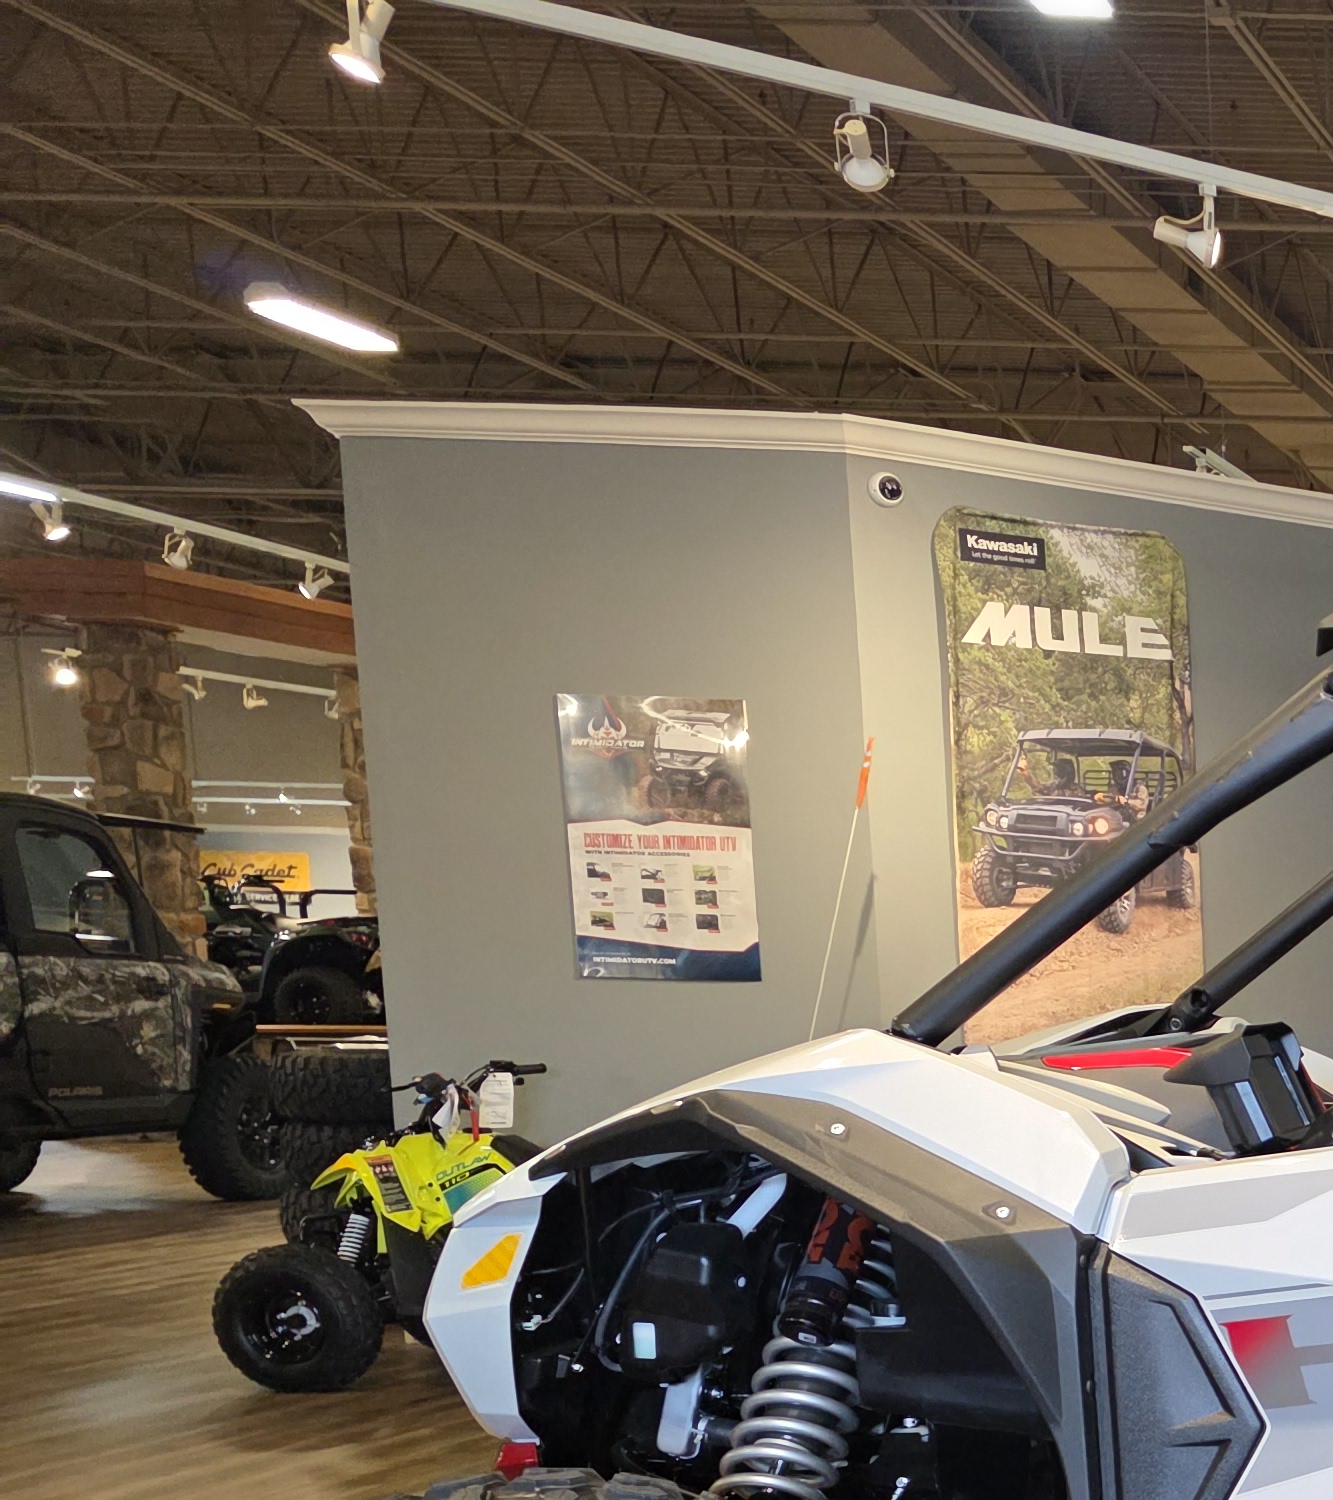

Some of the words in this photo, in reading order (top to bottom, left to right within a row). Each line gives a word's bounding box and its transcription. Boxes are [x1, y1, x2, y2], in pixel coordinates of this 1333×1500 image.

[966, 534, 1038, 556] Kawasaki
[961, 601, 1174, 661] MULE
[571, 738, 645, 748] INTIMIDATOR
[583, 832, 633, 849] CUSTOMIZE
[636, 834, 660, 850] YOUR
[663, 834, 716, 851] INTIMIDATOR
[719, 836, 737, 851] UTV
[240, 863, 298, 879] Cadet
[436, 1151, 493, 1182] OUTLAW
[444, 1171, 470, 1189] 110
